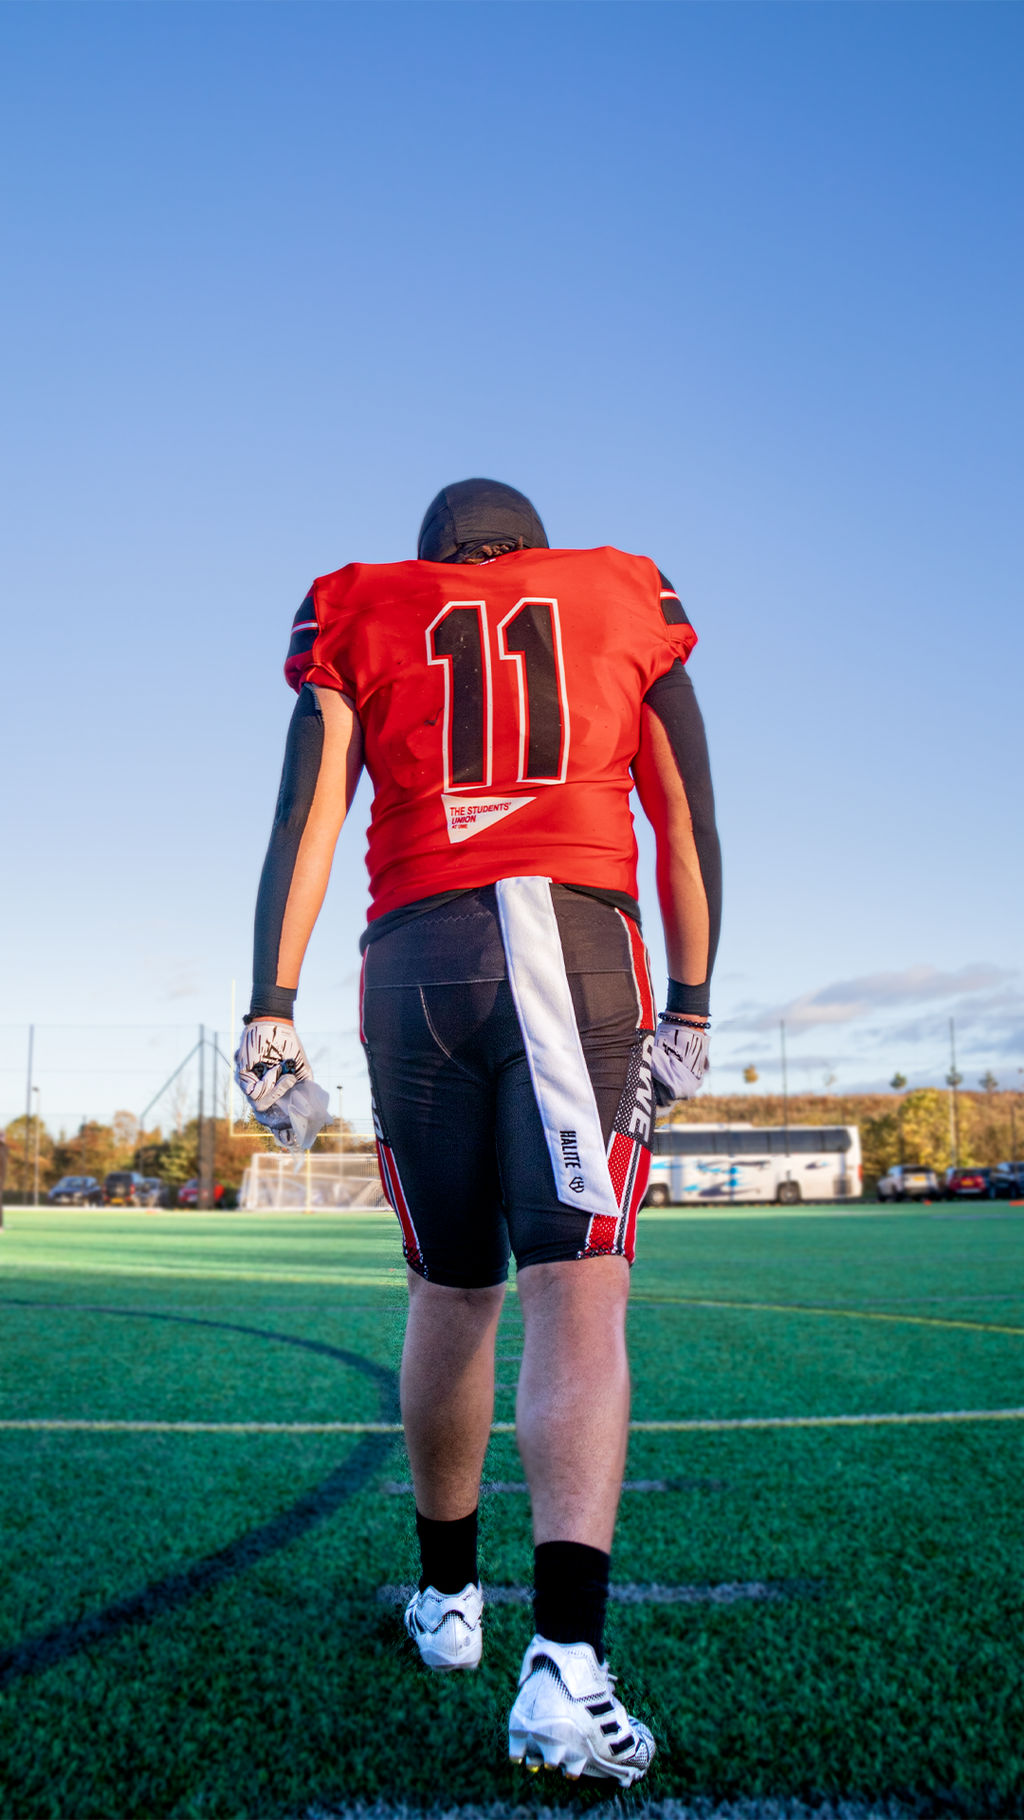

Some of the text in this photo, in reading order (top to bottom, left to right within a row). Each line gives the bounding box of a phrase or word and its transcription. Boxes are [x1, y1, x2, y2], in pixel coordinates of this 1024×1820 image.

[425, 597, 570, 793] 11
[450, 806, 466, 816] THE
[452, 815, 476, 824] UNION
[559, 1130, 581, 1169] HALITE
